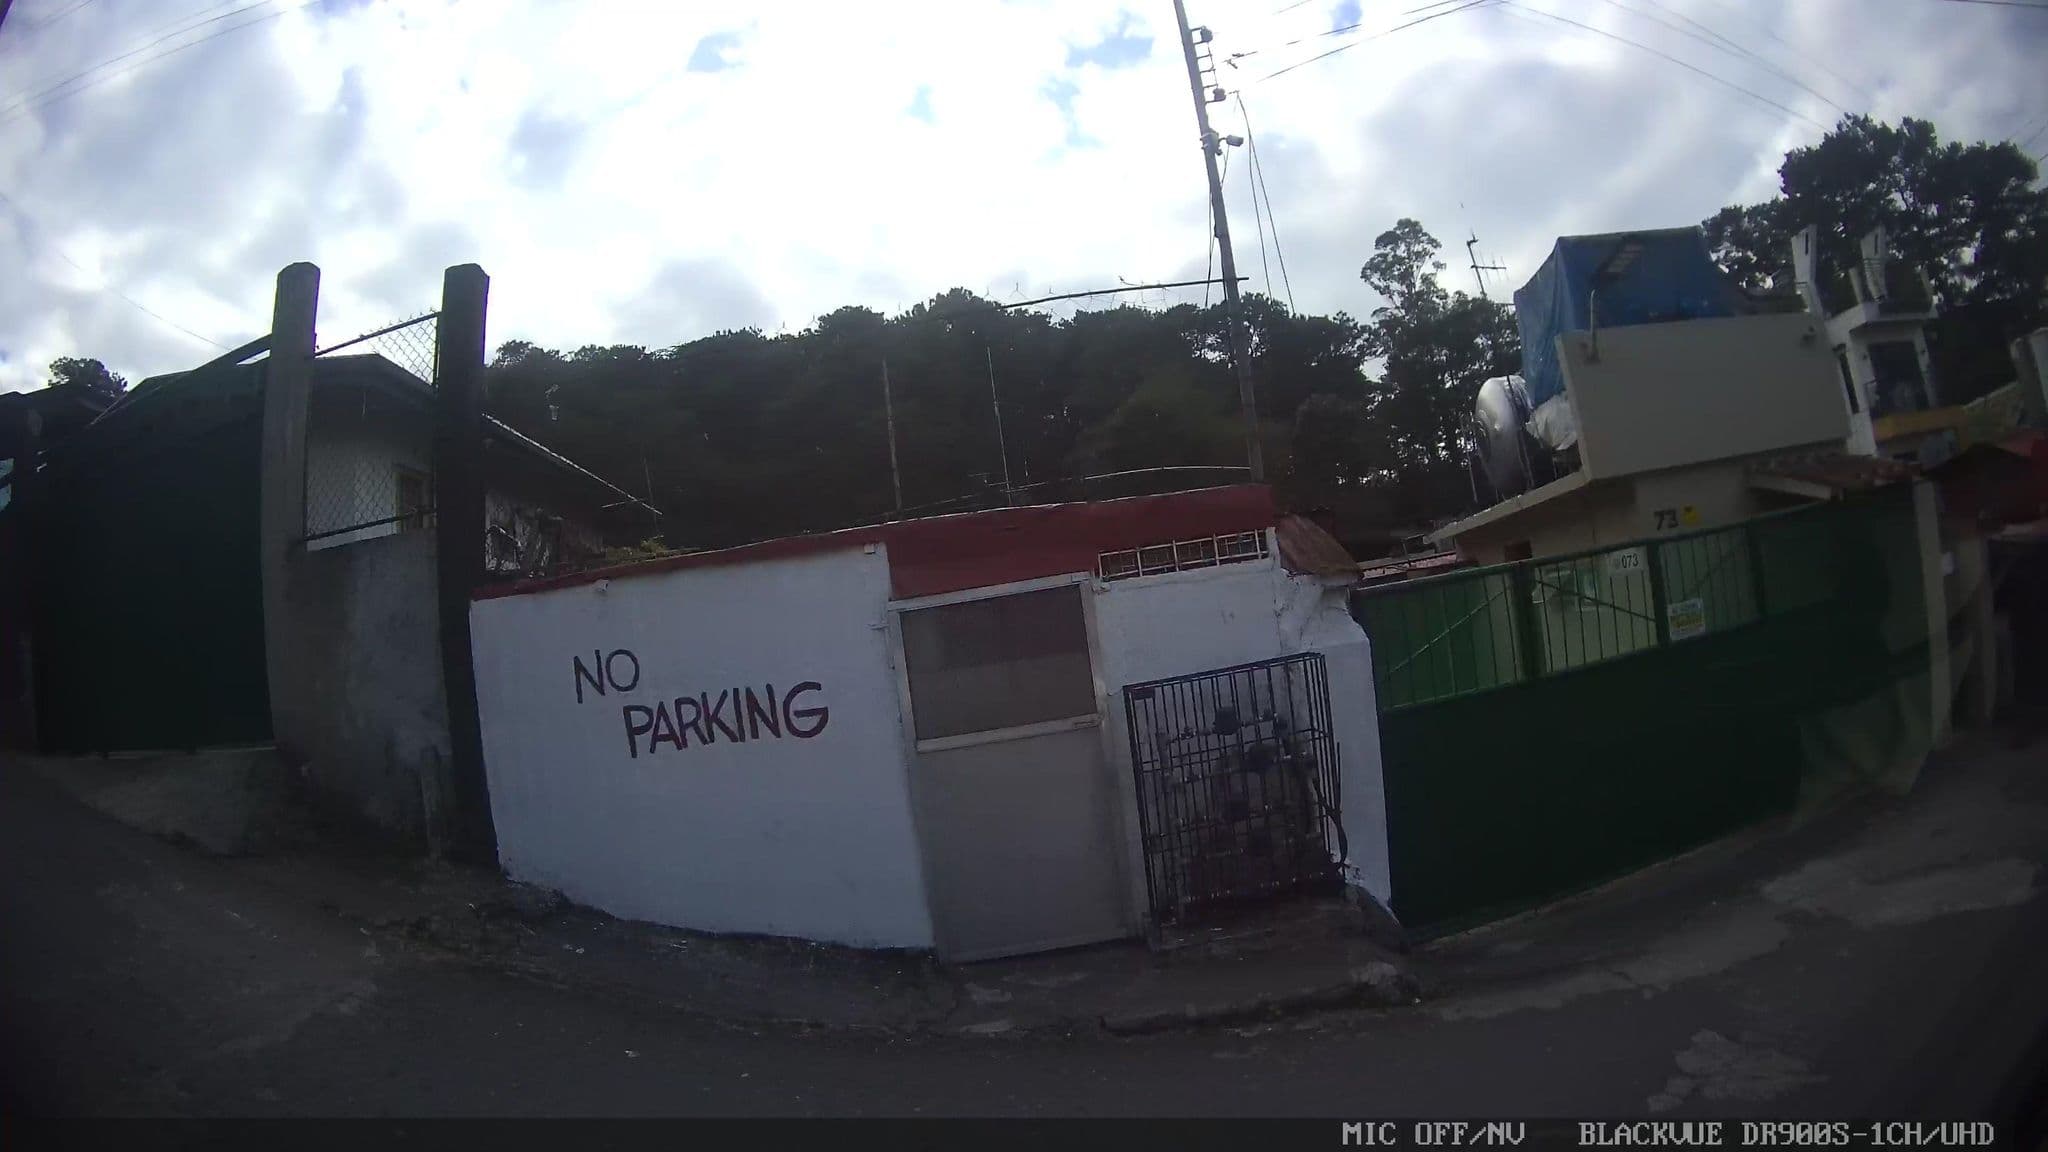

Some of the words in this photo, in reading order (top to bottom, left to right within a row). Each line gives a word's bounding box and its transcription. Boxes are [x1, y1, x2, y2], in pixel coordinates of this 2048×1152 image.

[1653, 509, 1679, 531] 73
[573, 648, 640, 704] NO
[622, 681, 829, 759] PARKING
